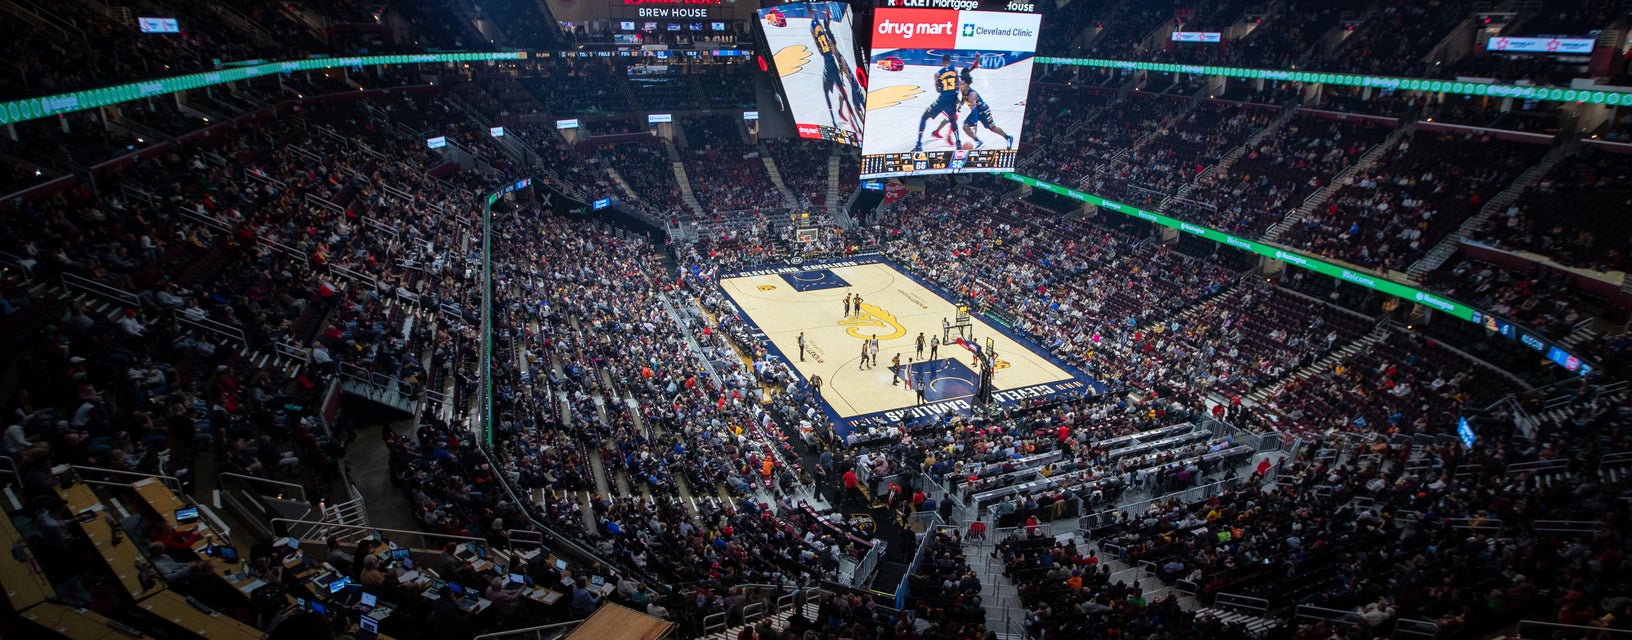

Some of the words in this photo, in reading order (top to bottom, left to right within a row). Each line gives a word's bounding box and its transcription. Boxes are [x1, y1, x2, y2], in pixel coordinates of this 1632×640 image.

[932, 0, 978, 10] Mortgage
[639, 8, 669, 17] BREW
[671, 8, 708, 18] HOUSE
[878, 19, 914, 39] drug
[916, 23, 953, 35] mart
[976, 26, 1011, 36] Cleveland
[1012, 28, 1033, 37] Clinic
[942, 77, 955, 91] 13
[915, 161, 927, 170] 66
[952, 160, 963, 169] 52
[1227, 236, 1252, 250] Welcome.
[739, 266, 799, 278] CLEVELAND
[802, 261, 858, 271] CAVALIERS
[1342, 269, 1376, 287] Welcome.
[990, 384, 1056, 403] CLEVELA
